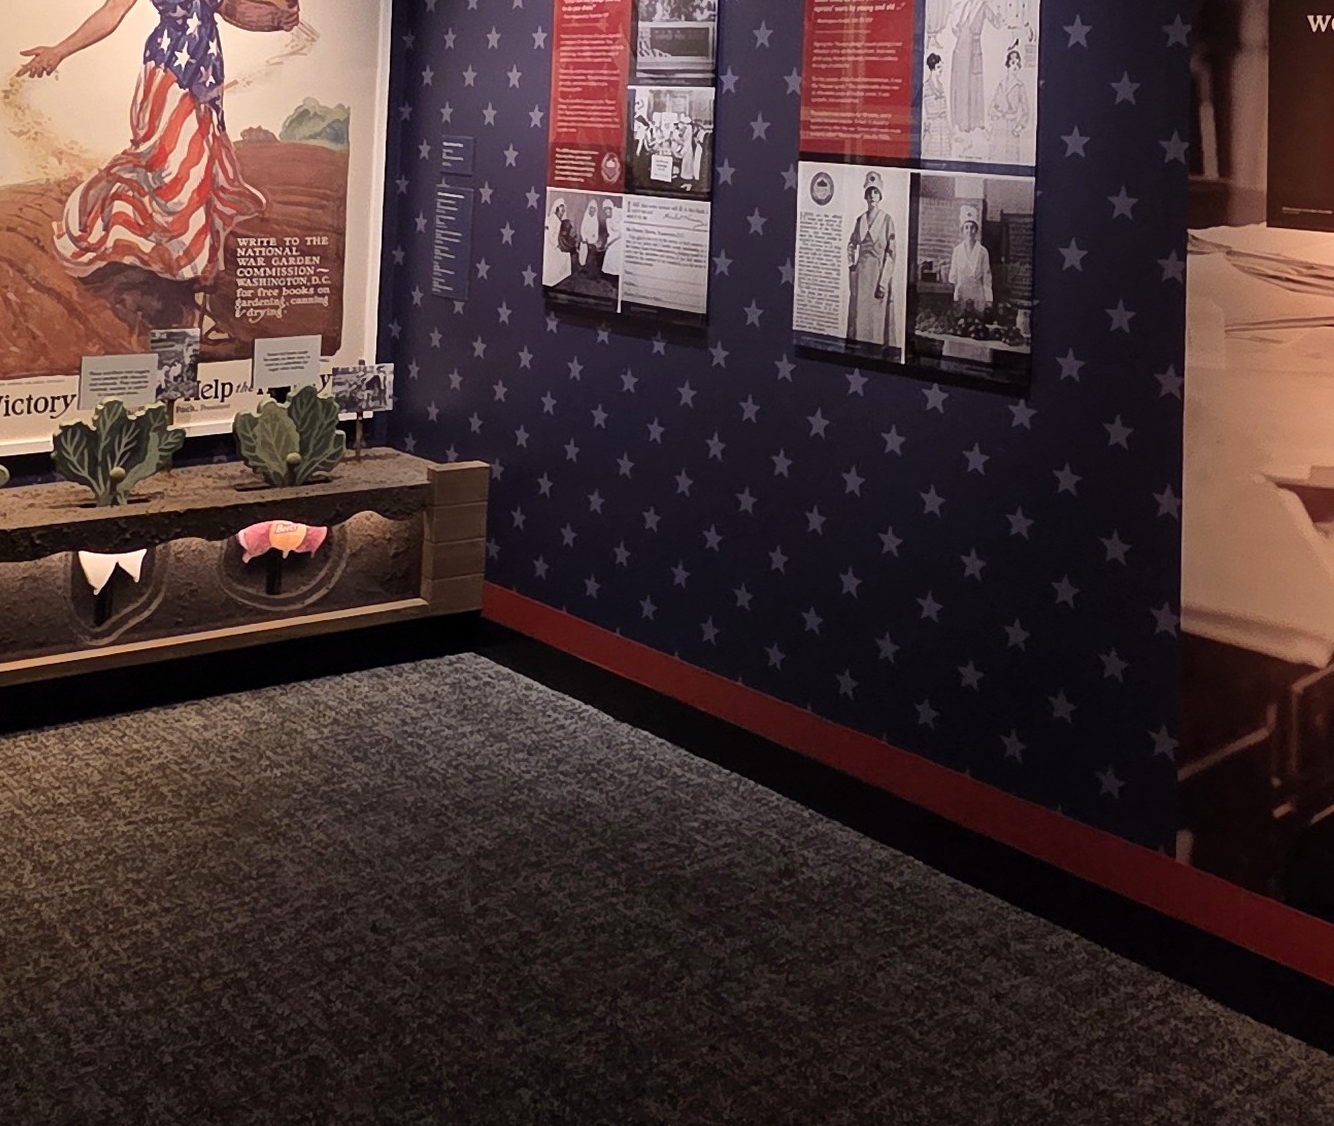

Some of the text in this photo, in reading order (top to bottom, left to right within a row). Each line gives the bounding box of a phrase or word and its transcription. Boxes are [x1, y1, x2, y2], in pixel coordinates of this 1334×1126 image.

[237, 236, 329, 247] WRITE TO THE
[236, 247, 300, 257] NATIONAL
[237, 256, 320, 266] WAR GARDEN
[236, 286, 330, 297] for free books on
